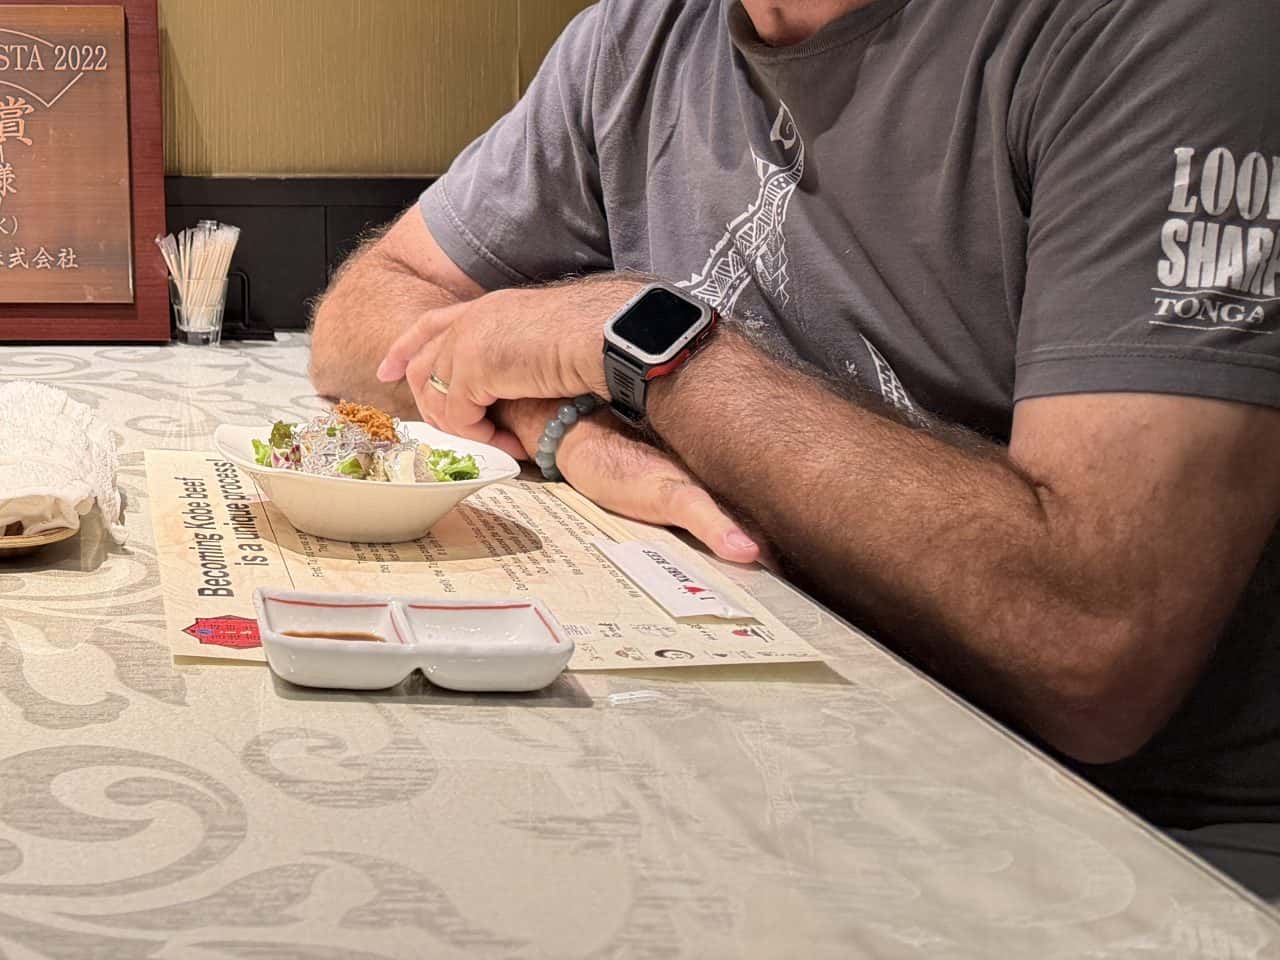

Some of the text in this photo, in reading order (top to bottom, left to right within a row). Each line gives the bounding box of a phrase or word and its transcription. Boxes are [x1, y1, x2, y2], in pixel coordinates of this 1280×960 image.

[54, 44, 109, 71] 2022
[1154, 297, 1265, 324] TONGA
[174, 476, 208, 499] beef
[182, 500, 217, 530] Kobe
[223, 501, 260, 540] unique
[234, 554, 270, 566] is
[238, 543, 265, 552] a
[189, 532, 235, 597] Becoming
